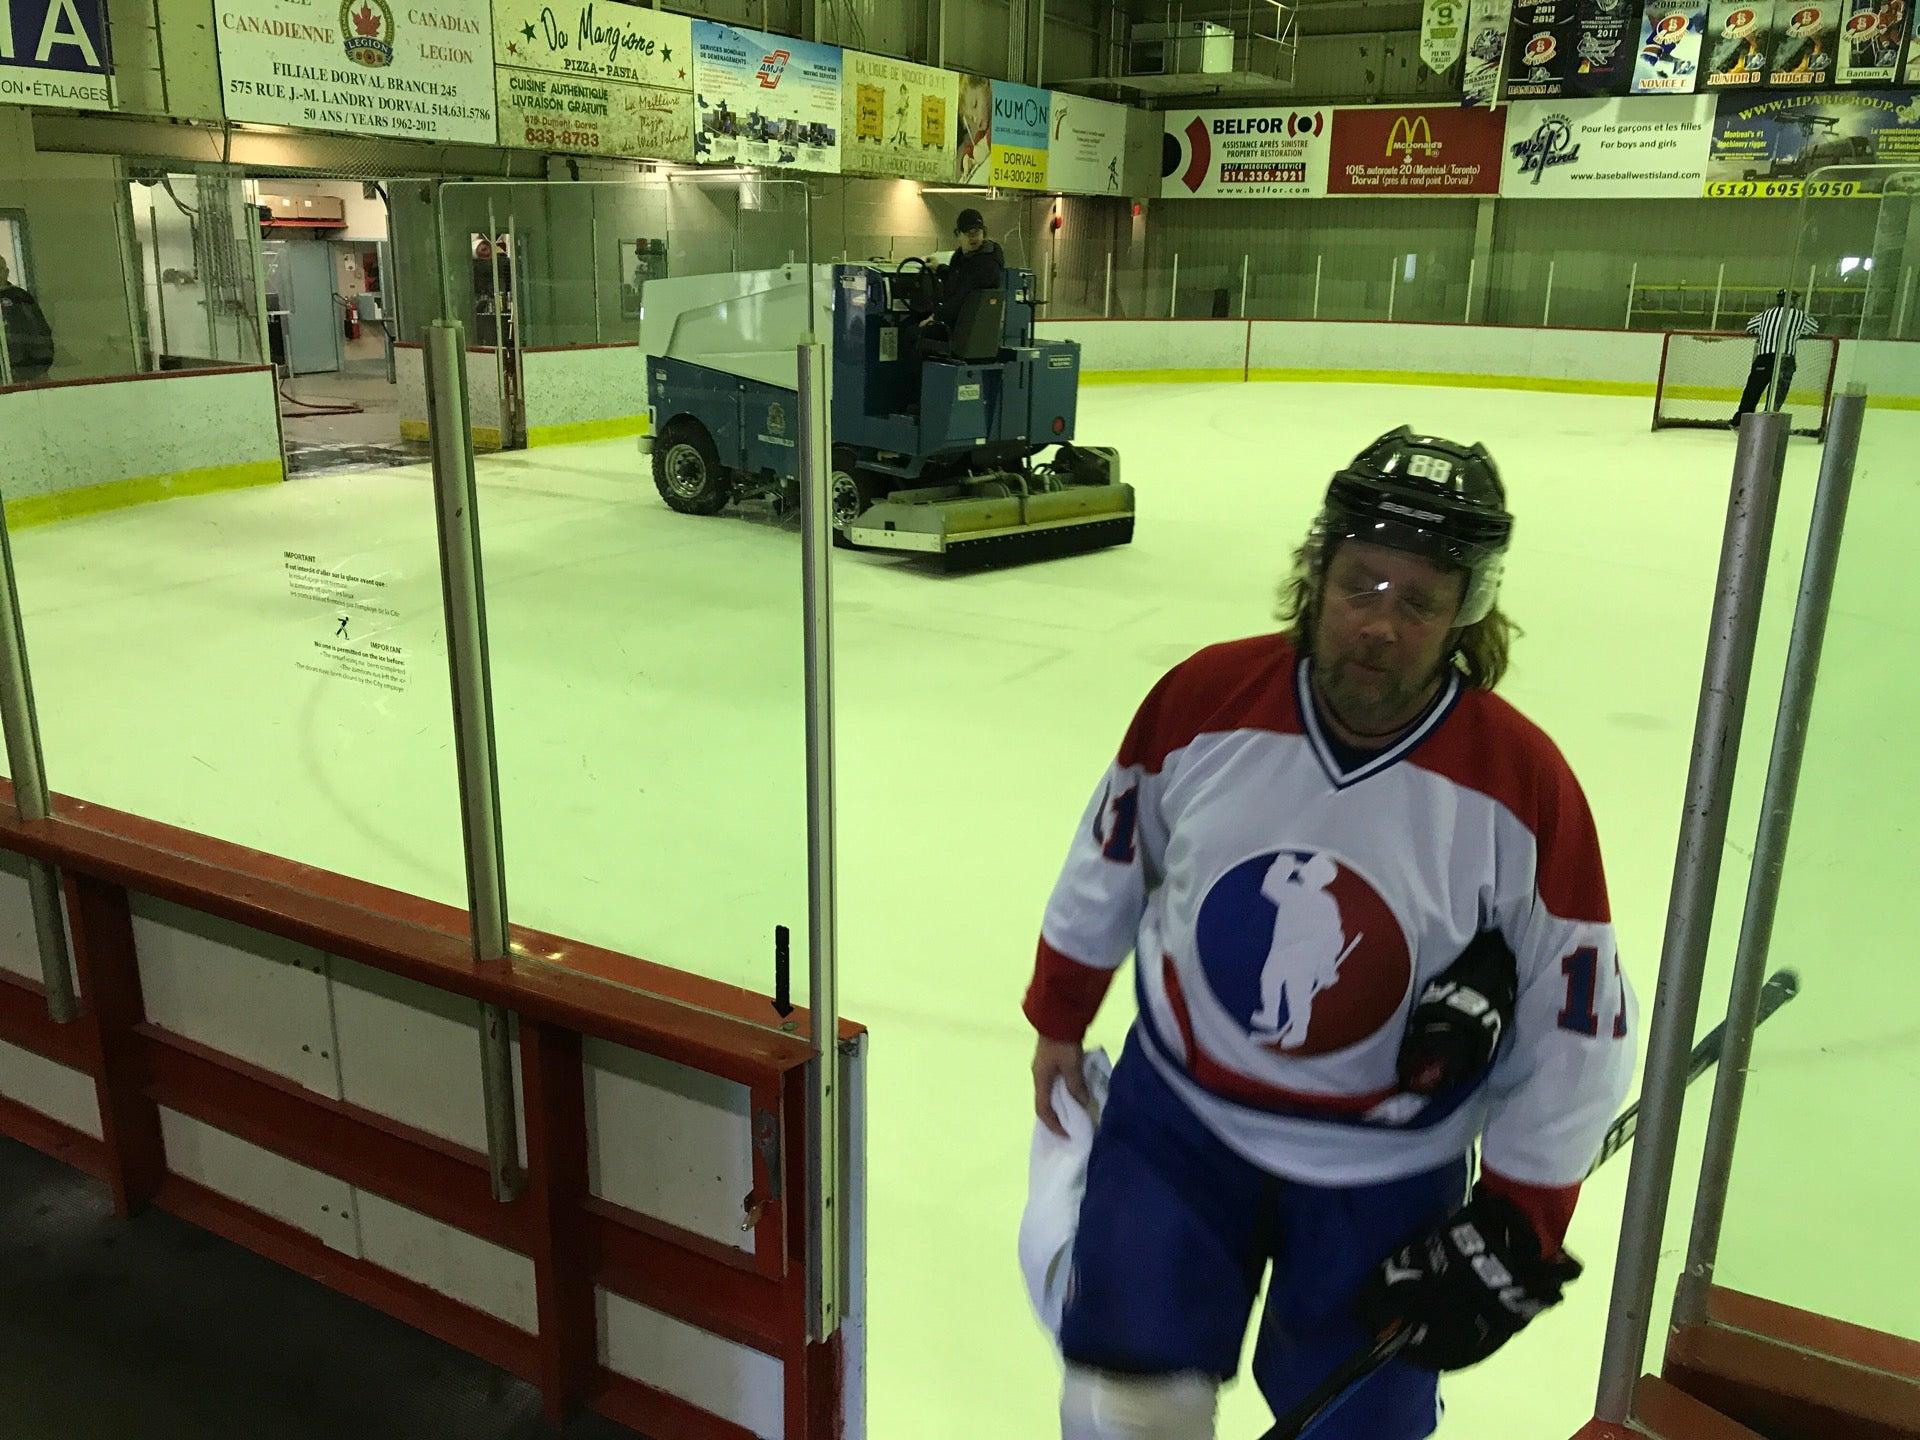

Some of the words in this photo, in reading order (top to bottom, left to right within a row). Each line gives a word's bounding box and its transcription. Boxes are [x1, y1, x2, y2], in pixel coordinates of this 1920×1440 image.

[222, 12, 335, 45] CANADIENNE
[407, 9, 481, 35] CANADIAN
[578, 2, 655, 62] Mangione
[1597, 29, 1619, 38] 2011
[348, 38, 388, 53] LEGION
[420, 43, 473, 64] LEGION
[759, 63, 779, 74] AMJ
[1846, 69, 1879, 78] Bantam
[273, 62, 328, 82] FILIALE
[331, 69, 385, 90] DORVAL
[388, 77, 439, 96] BRANCH
[440, 84, 457, 97] 245
[1707, 73, 1750, 85] JUNIOR
[1769, 72, 1815, 84] MIDGET
[510, 77, 546, 93] CUISINE
[551, 83, 609, 101] AUTHENTIQUE
[230, 79, 253, 95] 575
[256, 82, 286, 99] RUE
[288, 87, 320, 103] J.-M.
[322, 90, 374, 110] LANDRY
[378, 98, 429, 115] DORVAL
[431, 105, 491, 121] 514.631.5786
[512, 94, 563, 111] LIVRAISON
[567, 100, 608, 116] GRATUITE
[994, 98, 1048, 127] KUMON
[303, 108, 316, 121] 50
[319, 110, 343, 124] ANS
[344, 113, 349, 124] /
[351, 113, 389, 128] YEARS
[391, 118, 437, 133] 1962-2012
[1213, 118, 1283, 135] BELFOR
[1581, 124, 1603, 134] Pour
[1603, 124, 1616, 133] les
[1617, 123, 1652, 135] garçons
[1654, 123, 1664, 133] et
[1665, 122, 1679, 132] les
[1680, 121, 1702, 132] filles
[1222, 140, 1258, 149] ASSISTANCE
[1281, 139, 1309, 148] SINISTRE
[1600, 140, 1615, 149] For
[1616, 140, 1638, 150] boys
[1639, 139, 1656, 149] and
[1657, 139, 1677, 150] girls
[1003, 152, 1037, 167] DORVAL
[1226, 149, 1259, 158] PROPERTY
[1260, 148, 1303, 158] RESTORATION
[993, 167, 1044, 184] 514-300-2187
[1223, 170, 1303, 182] 514.336.2921
[1400, 164, 1413, 175] 20
[1570, 170, 1701, 181] www.baseballwestisland.com
[1351, 175, 1380, 185] Dorval
[1217, 185, 1310, 195] www.belfor.com
[1707, 181, 1758, 198] (514)
[283, 551, 316, 563] IMPORTANT
